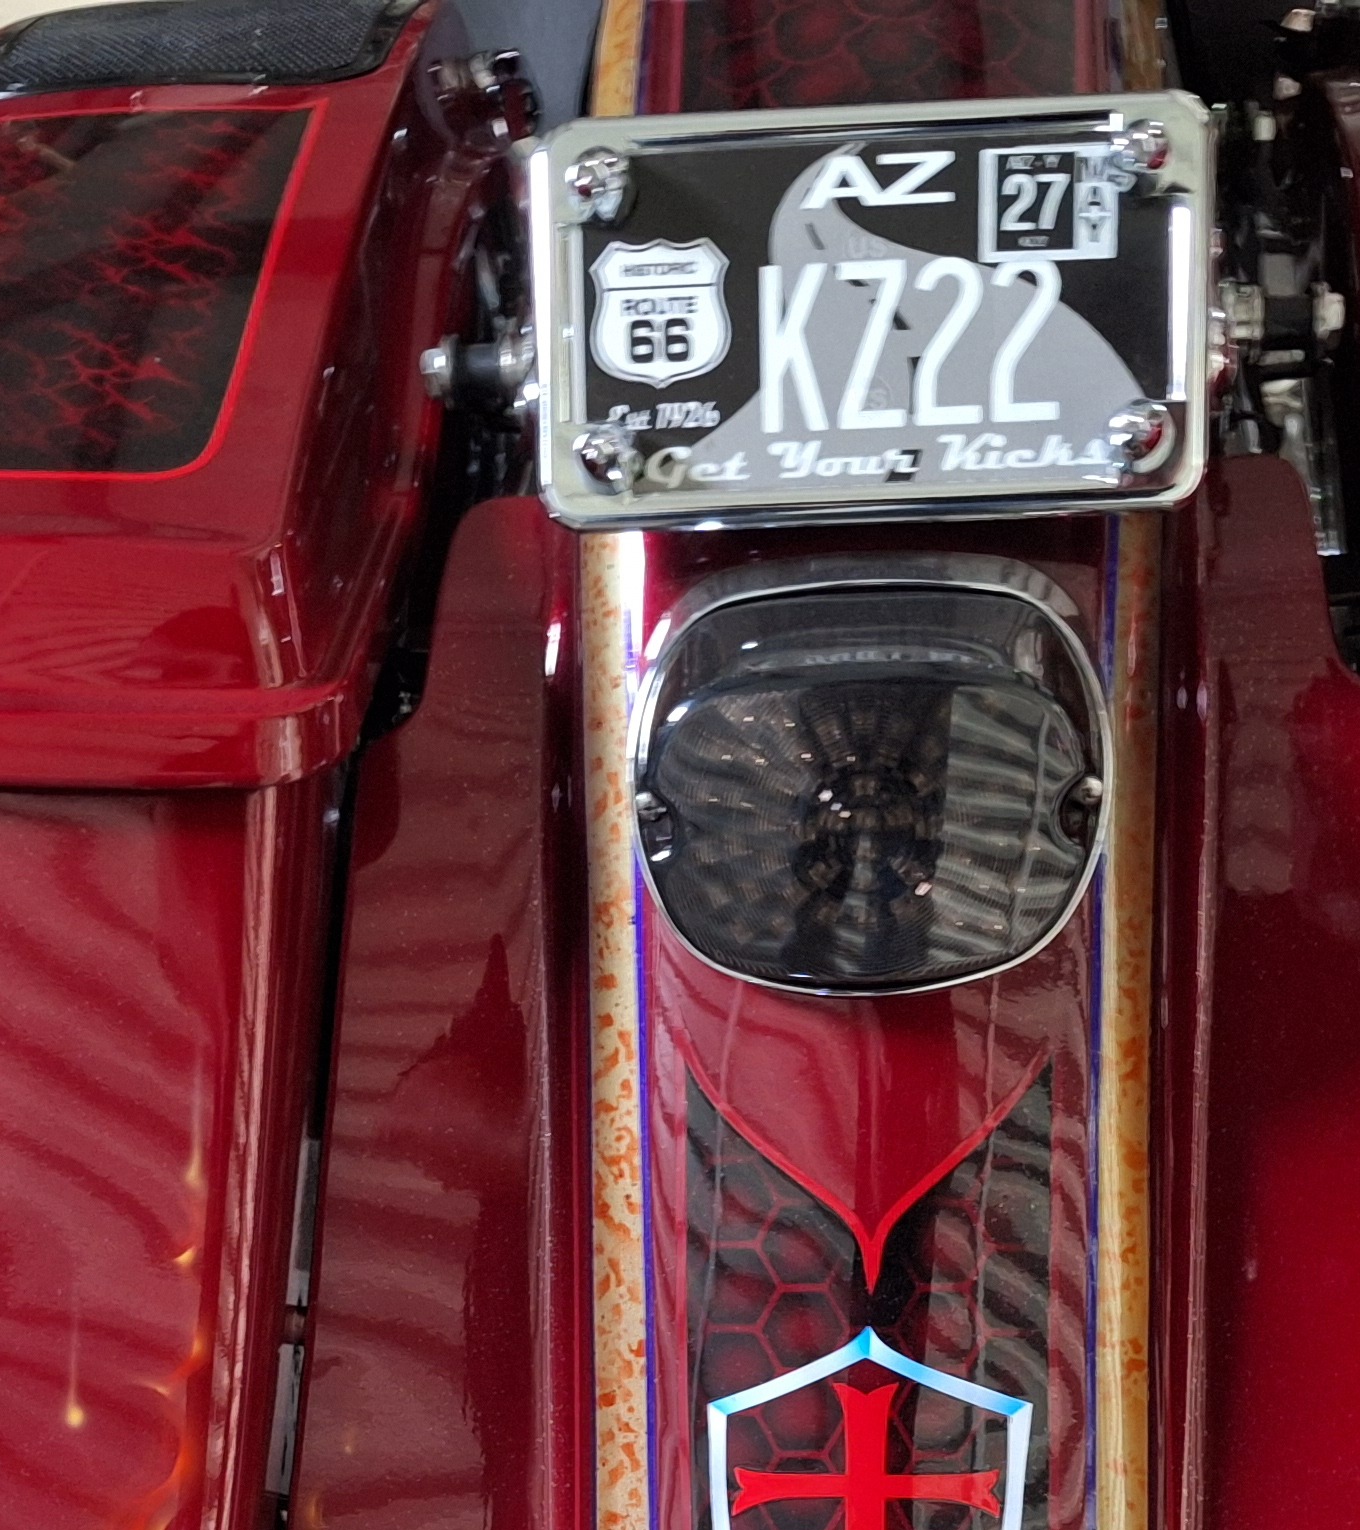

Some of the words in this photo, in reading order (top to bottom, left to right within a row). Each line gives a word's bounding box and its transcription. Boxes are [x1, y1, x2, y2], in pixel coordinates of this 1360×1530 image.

[799, 150, 955, 210] AZ
[1000, 173, 1071, 231] 27
[621, 296, 698, 316] ROUTE
[630, 318, 690, 363] 66
[759, 256, 1061, 433] KZ22
[645, 447, 751, 488] Get
[768, 440, 918, 479] Your
